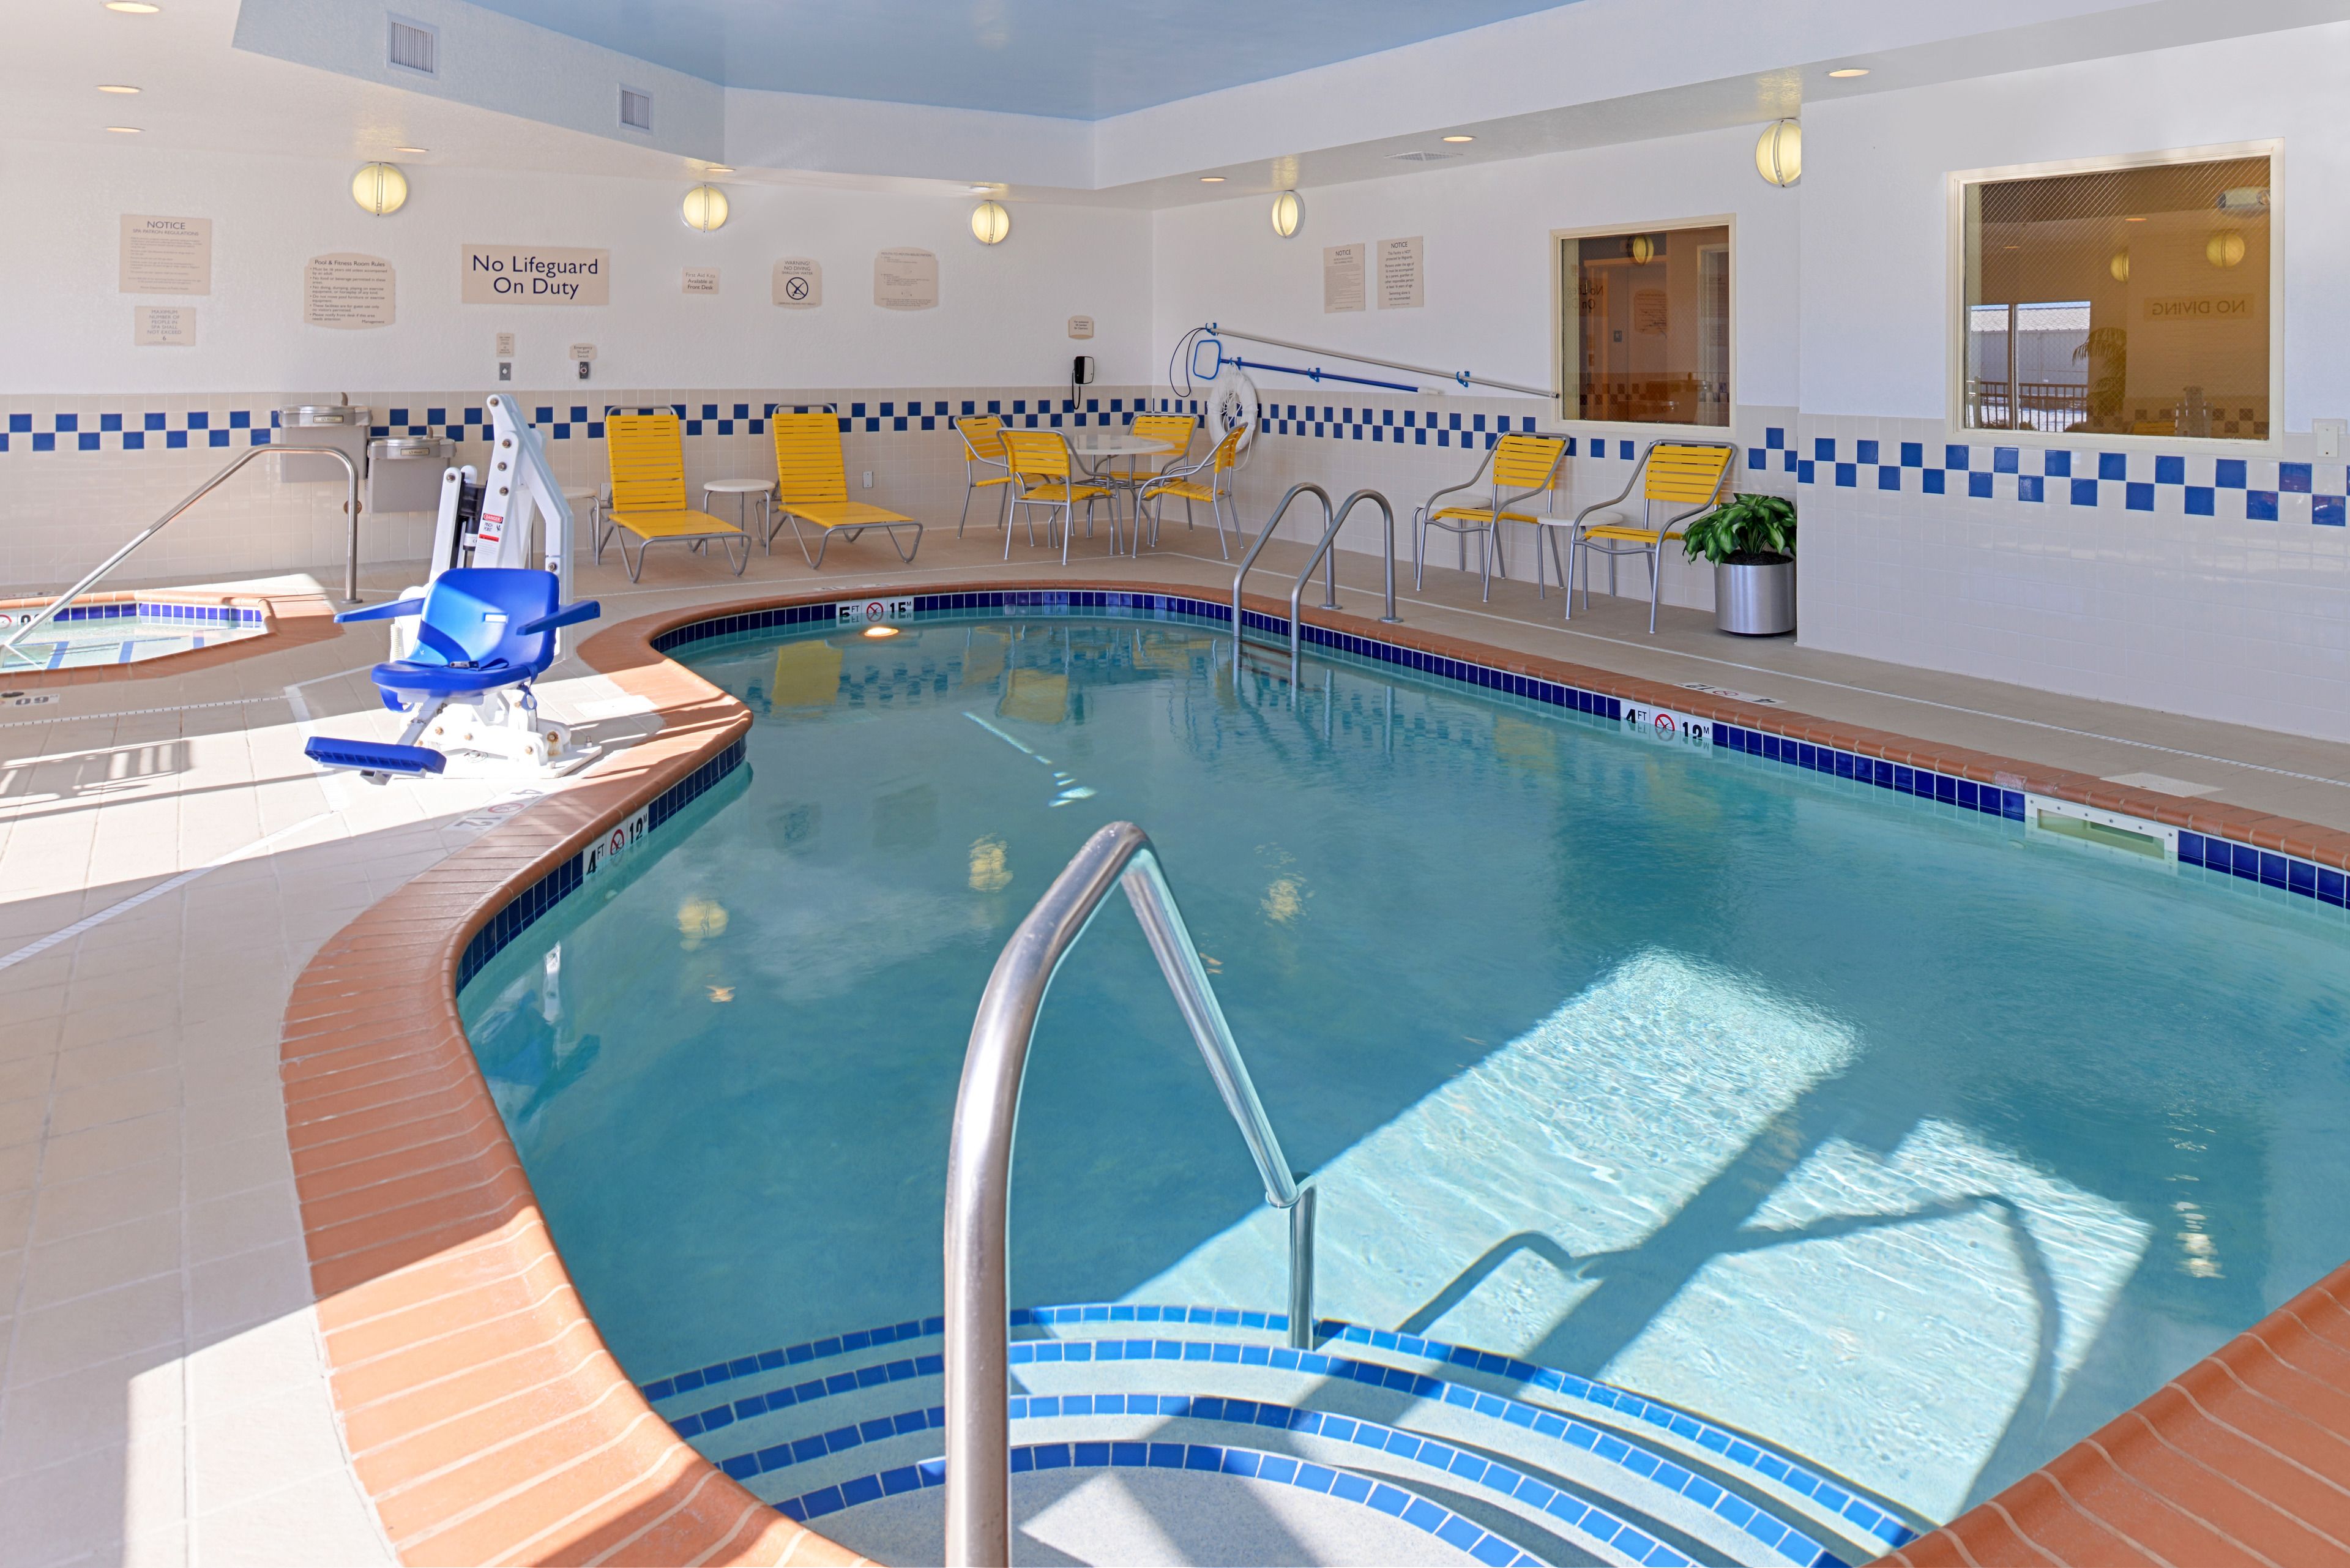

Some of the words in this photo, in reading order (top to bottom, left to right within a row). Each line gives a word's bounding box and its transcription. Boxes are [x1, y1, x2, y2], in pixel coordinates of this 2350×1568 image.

[147, 220, 186, 230] NOTICE
[473, 254, 504, 272] No
[513, 255, 598, 278] Lifeguard
[493, 276, 524, 294] On
[533, 278, 580, 300] Duty
